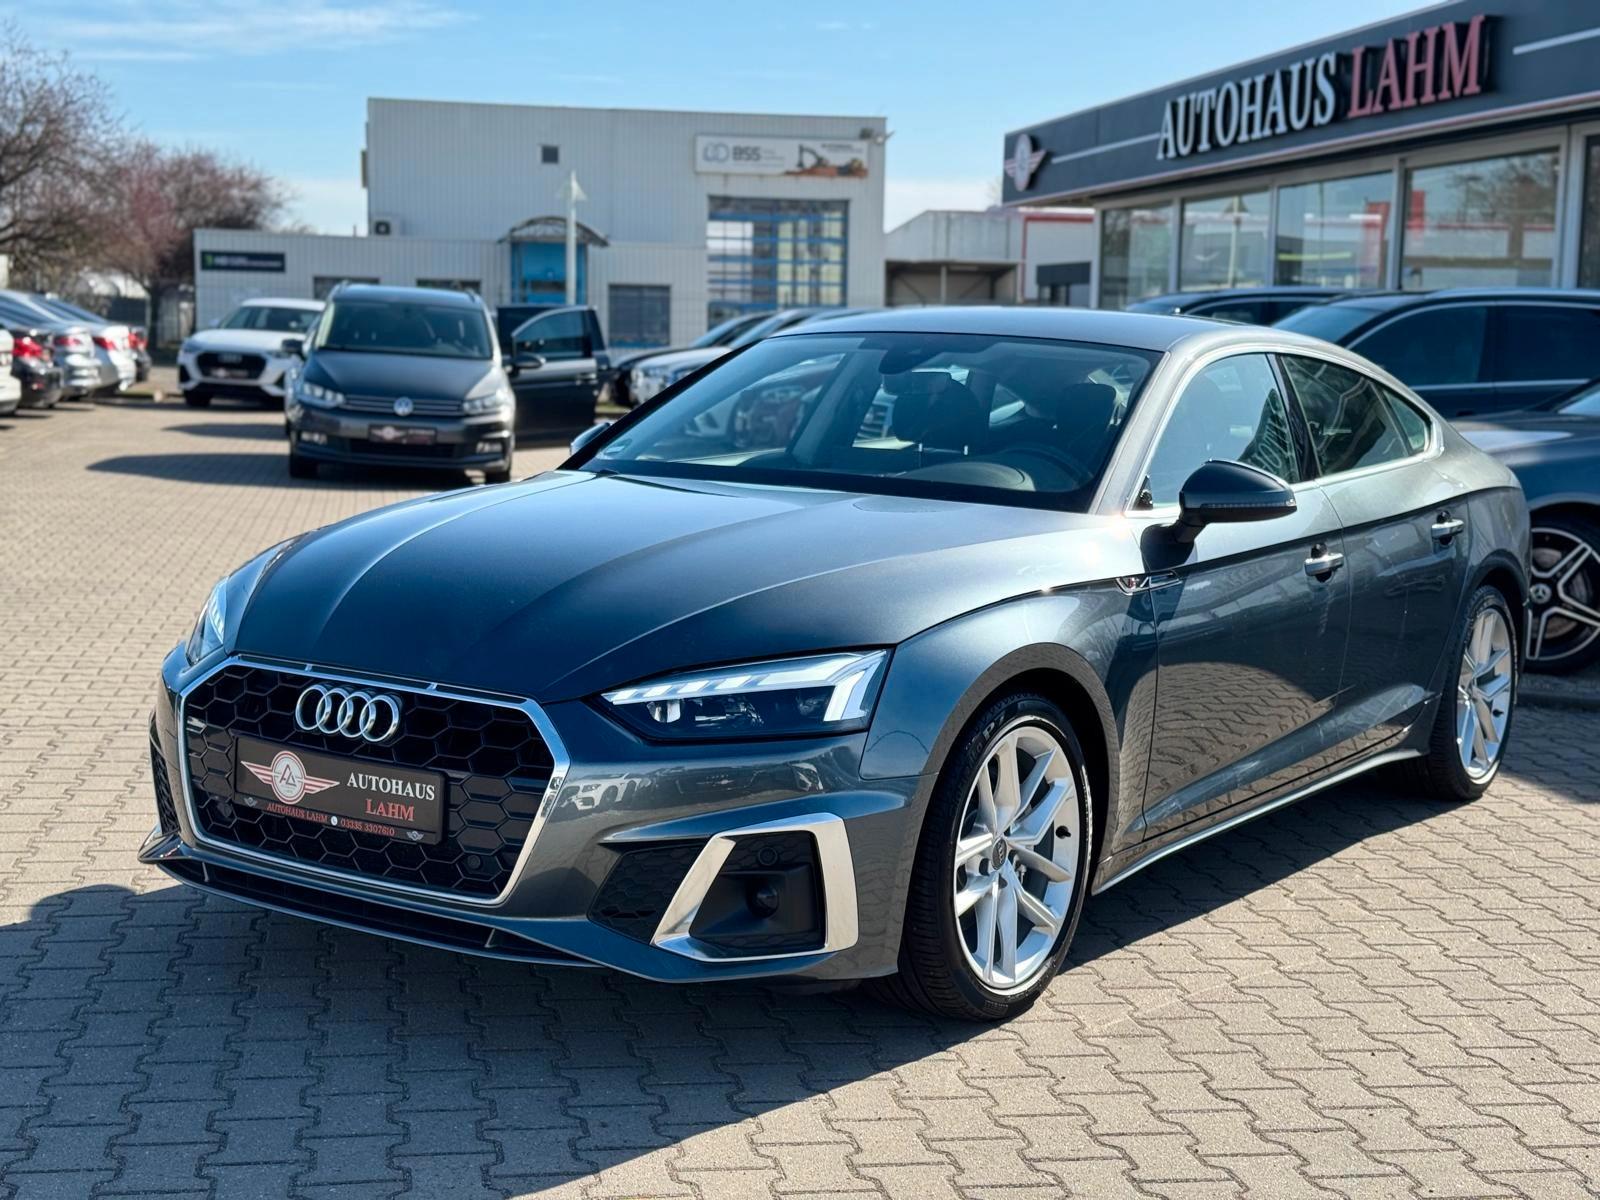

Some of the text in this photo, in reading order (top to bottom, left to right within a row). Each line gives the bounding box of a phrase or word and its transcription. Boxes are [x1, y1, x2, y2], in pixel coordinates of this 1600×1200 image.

[1156, 14, 1485, 160] AUTOHAUS LAHM
[732, 145, 761, 161] BSS
[346, 772, 436, 801] AUTOHAUS
[266, 802, 306, 819] AUTOHAUS
[306, 811, 328, 824] LAHM
[365, 798, 415, 822] LAHM
